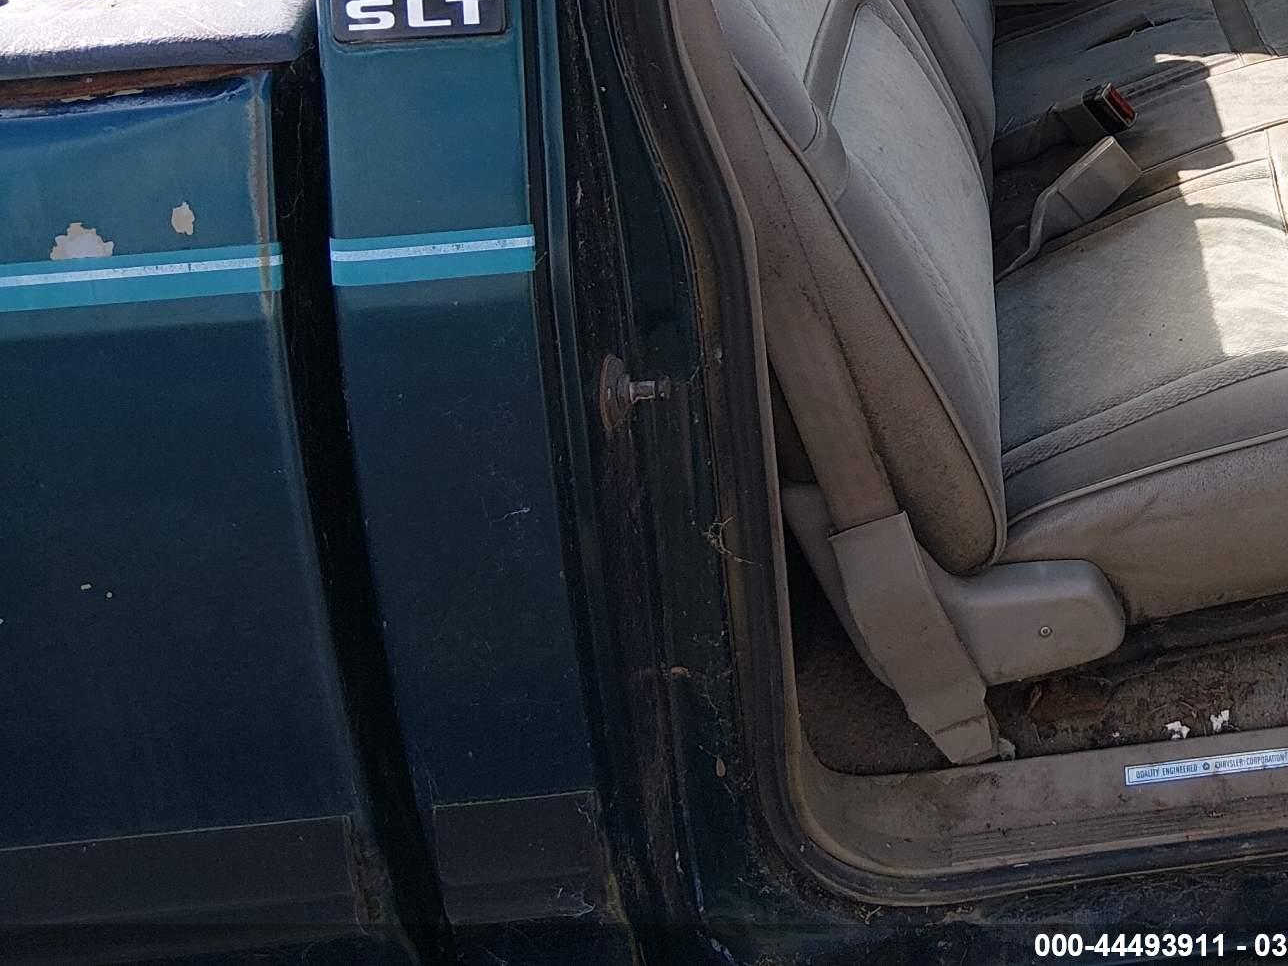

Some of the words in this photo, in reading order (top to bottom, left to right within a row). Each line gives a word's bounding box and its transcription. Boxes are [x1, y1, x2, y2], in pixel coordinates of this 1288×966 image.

[1135, 767, 1160, 779] QUALITY
[1162, 764, 1198, 776] ENGINEERED
[1214, 758, 1243, 769] CHRYSLER
[1246, 753, 1285, 766] CORPORATION
